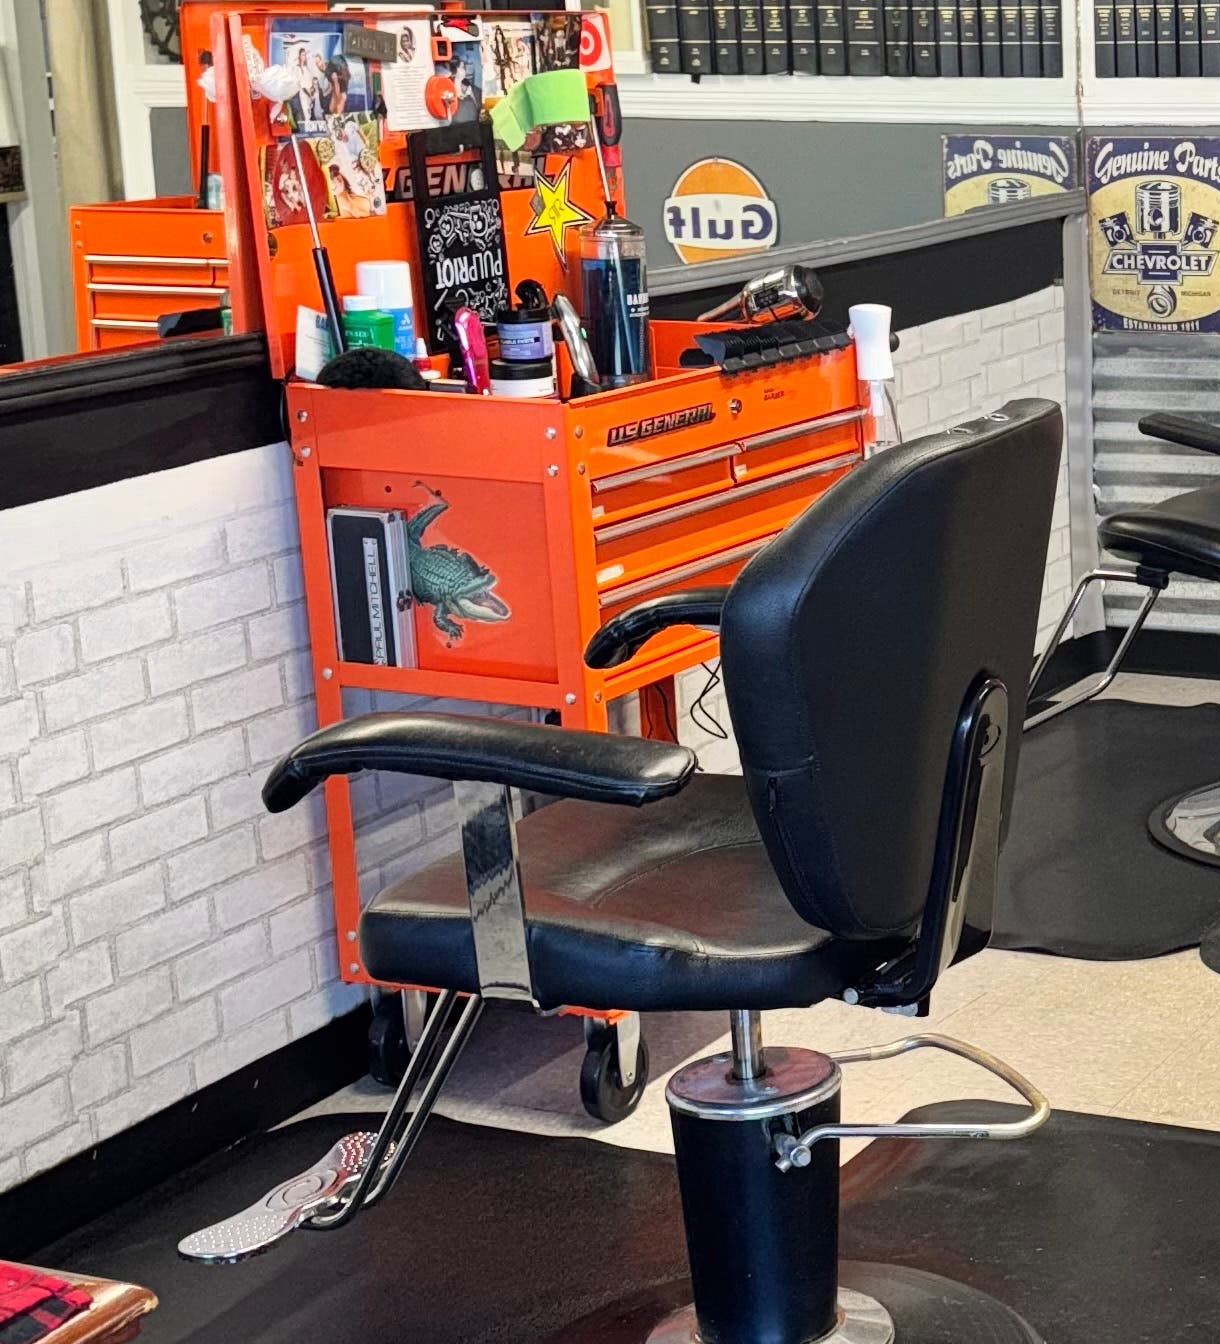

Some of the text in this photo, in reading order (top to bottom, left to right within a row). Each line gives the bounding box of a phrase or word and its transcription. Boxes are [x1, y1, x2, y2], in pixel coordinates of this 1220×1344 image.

[1094, 141, 1170, 184] Genuine
[1112, 254, 1209, 270] CHEVROLET
[1123, 318, 1200, 331] ESTABLISHED 1911
[366, 550, 386, 660] PAUL MITCHELL
